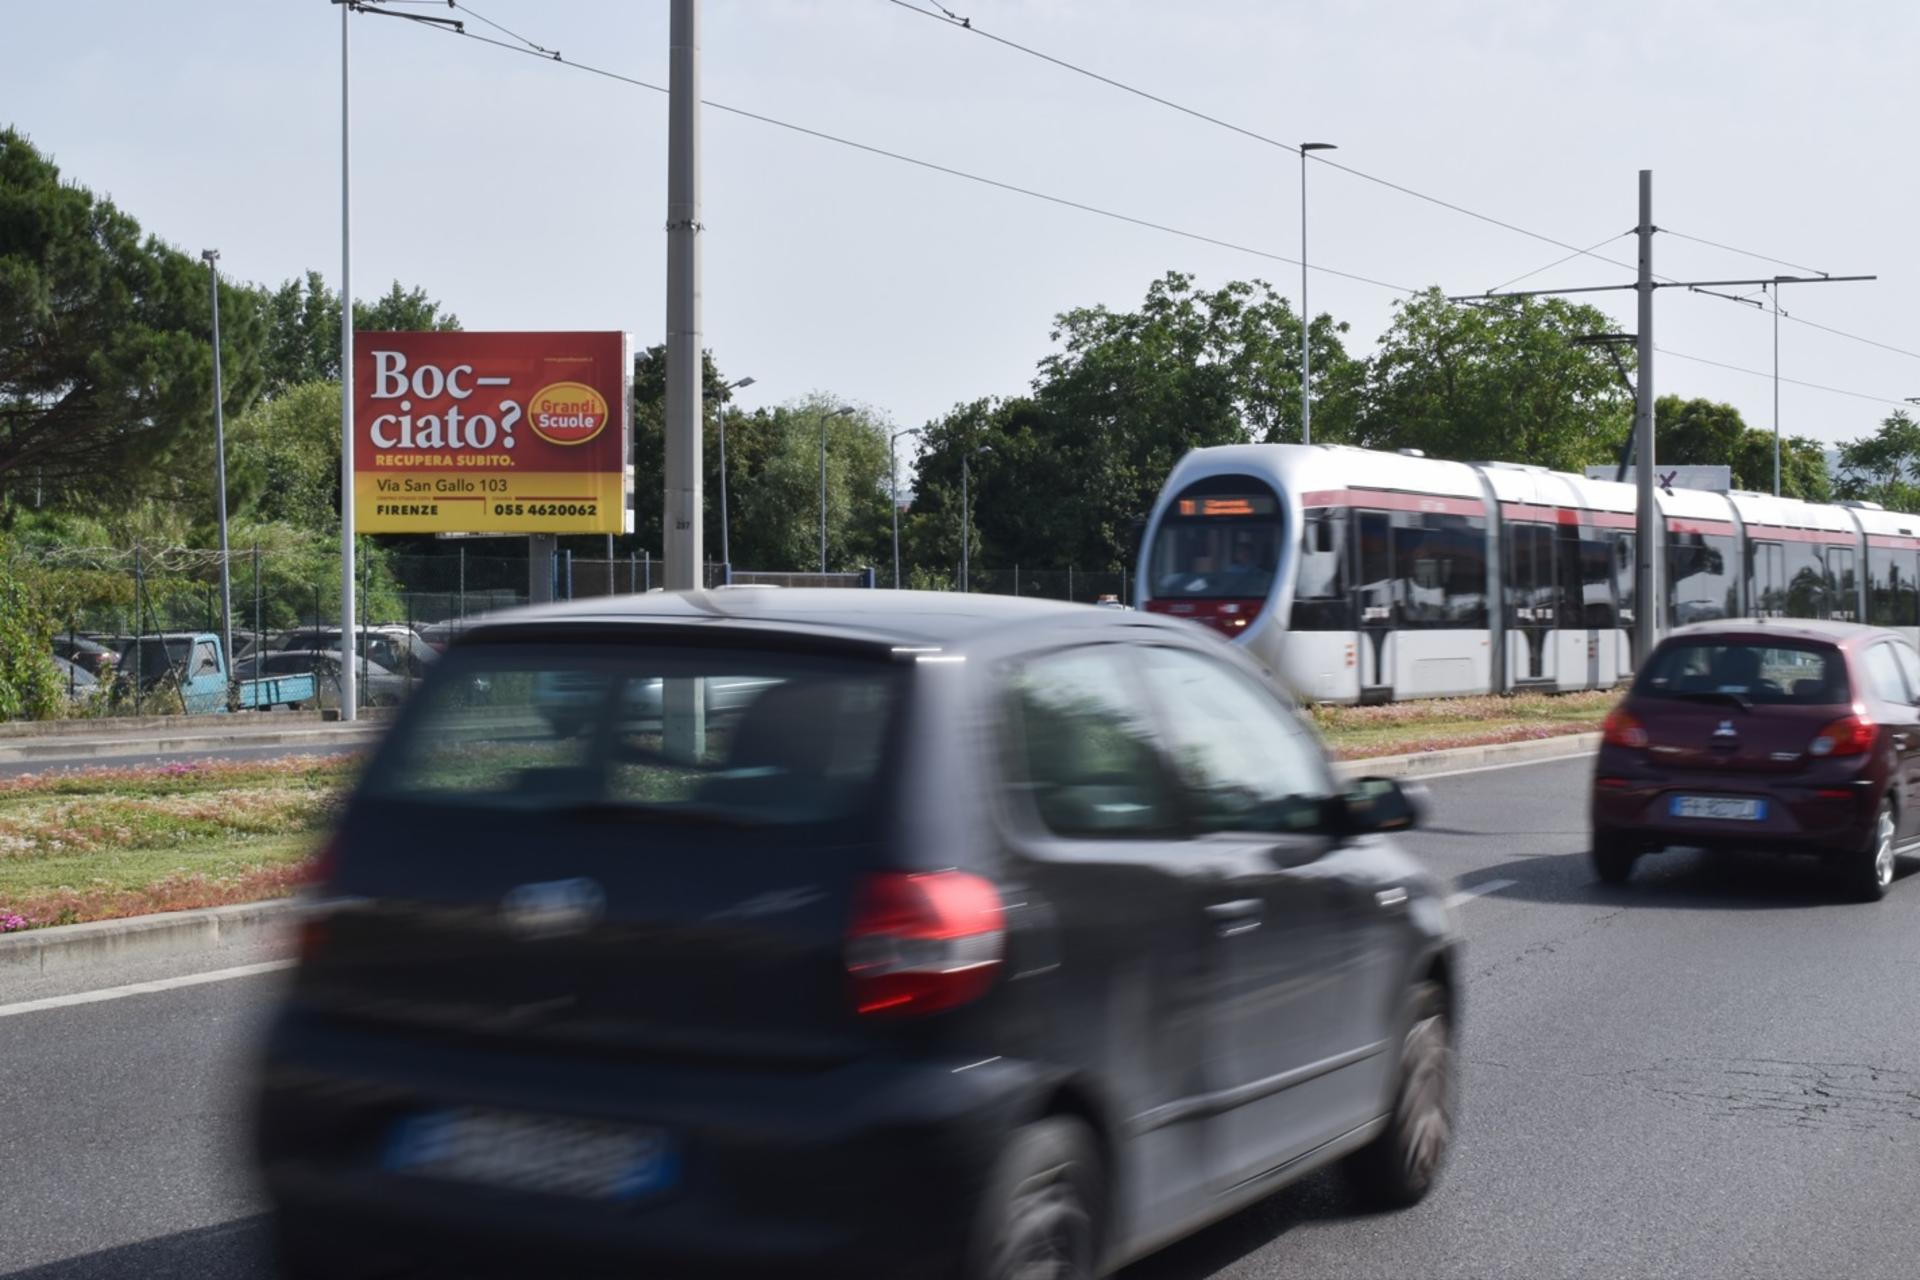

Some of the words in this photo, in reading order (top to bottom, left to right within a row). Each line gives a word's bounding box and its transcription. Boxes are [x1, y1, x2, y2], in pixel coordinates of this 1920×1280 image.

[541, 399, 596, 414] Grandi
[370, 399, 522, 449] ciato?
[539, 412, 594, 428] Scuole
[375, 454, 454, 467] RECUPERA
[456, 454, 515, 467] SUBITO.
[376, 479, 400, 492] Via
[404, 479, 432, 492] San
[435, 478, 475, 492] Gallo
[480, 479, 508, 492] 103
[376, 505, 439, 516] FIRENZE
[494, 504, 524, 516] 055
[527, 504, 597, 516] 4620062
